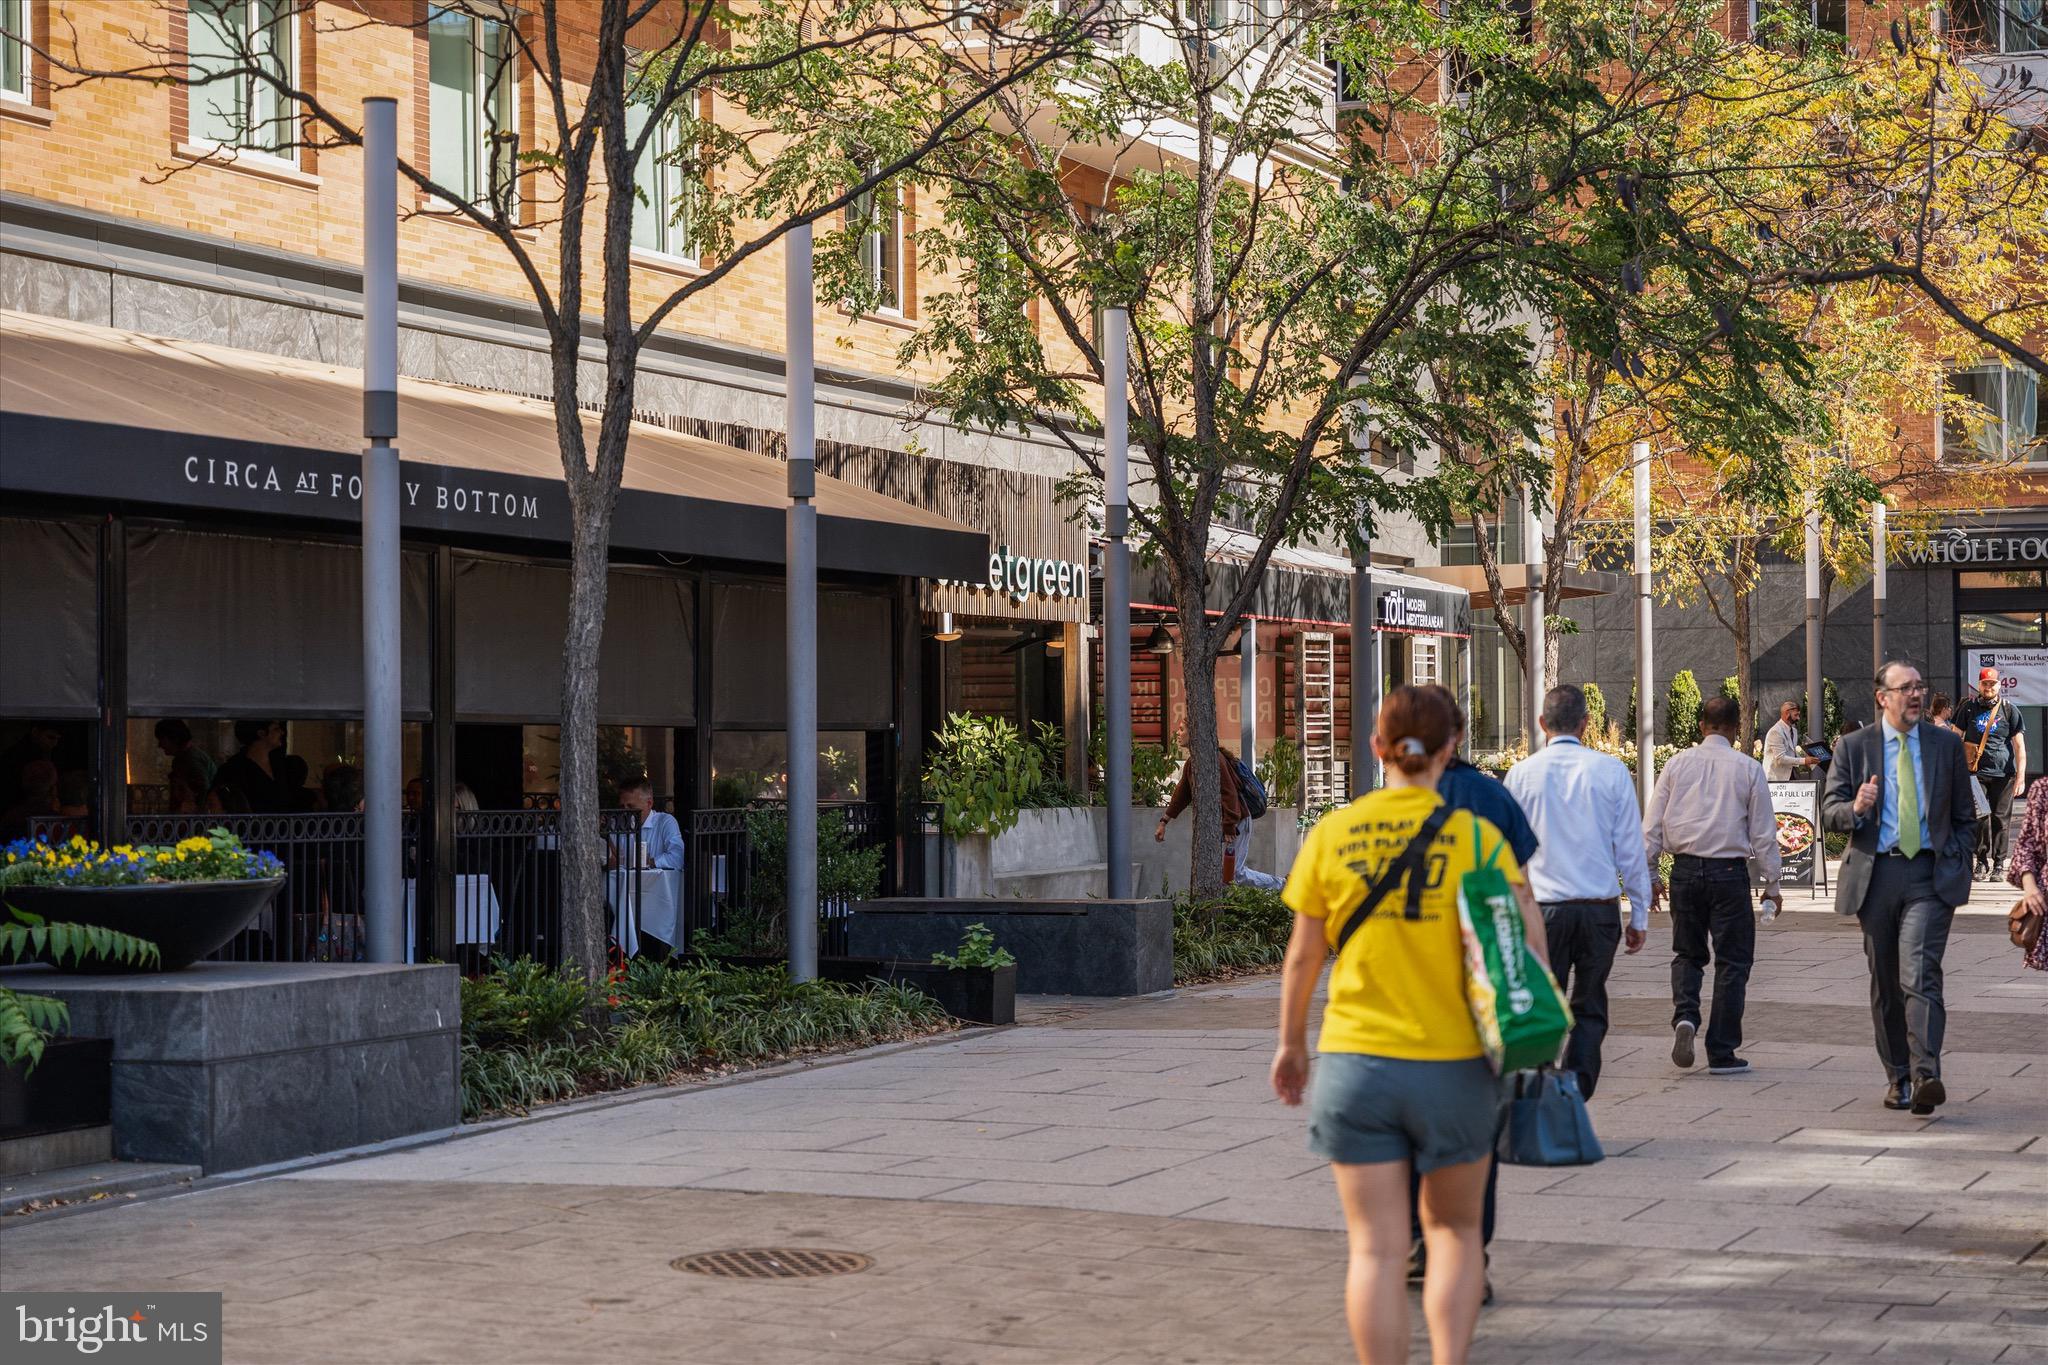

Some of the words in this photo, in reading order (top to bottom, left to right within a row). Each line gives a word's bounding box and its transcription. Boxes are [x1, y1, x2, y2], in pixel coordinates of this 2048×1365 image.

[184, 456, 281, 491] CIRCA
[295, 472, 318, 493] AT
[331, 474, 420, 506] FOY
[436, 486, 538, 518] BOTTOM
[1903, 534, 2003, 564] WHOLE
[938, 545, 1086, 602] etgreen
[1406, 599, 1427, 612] MODERN
[1406, 613, 1444, 628] MEDITERRANEAN
[1981, 655, 1995, 663] 365
[1376, 820, 1413, 832] PLAY
